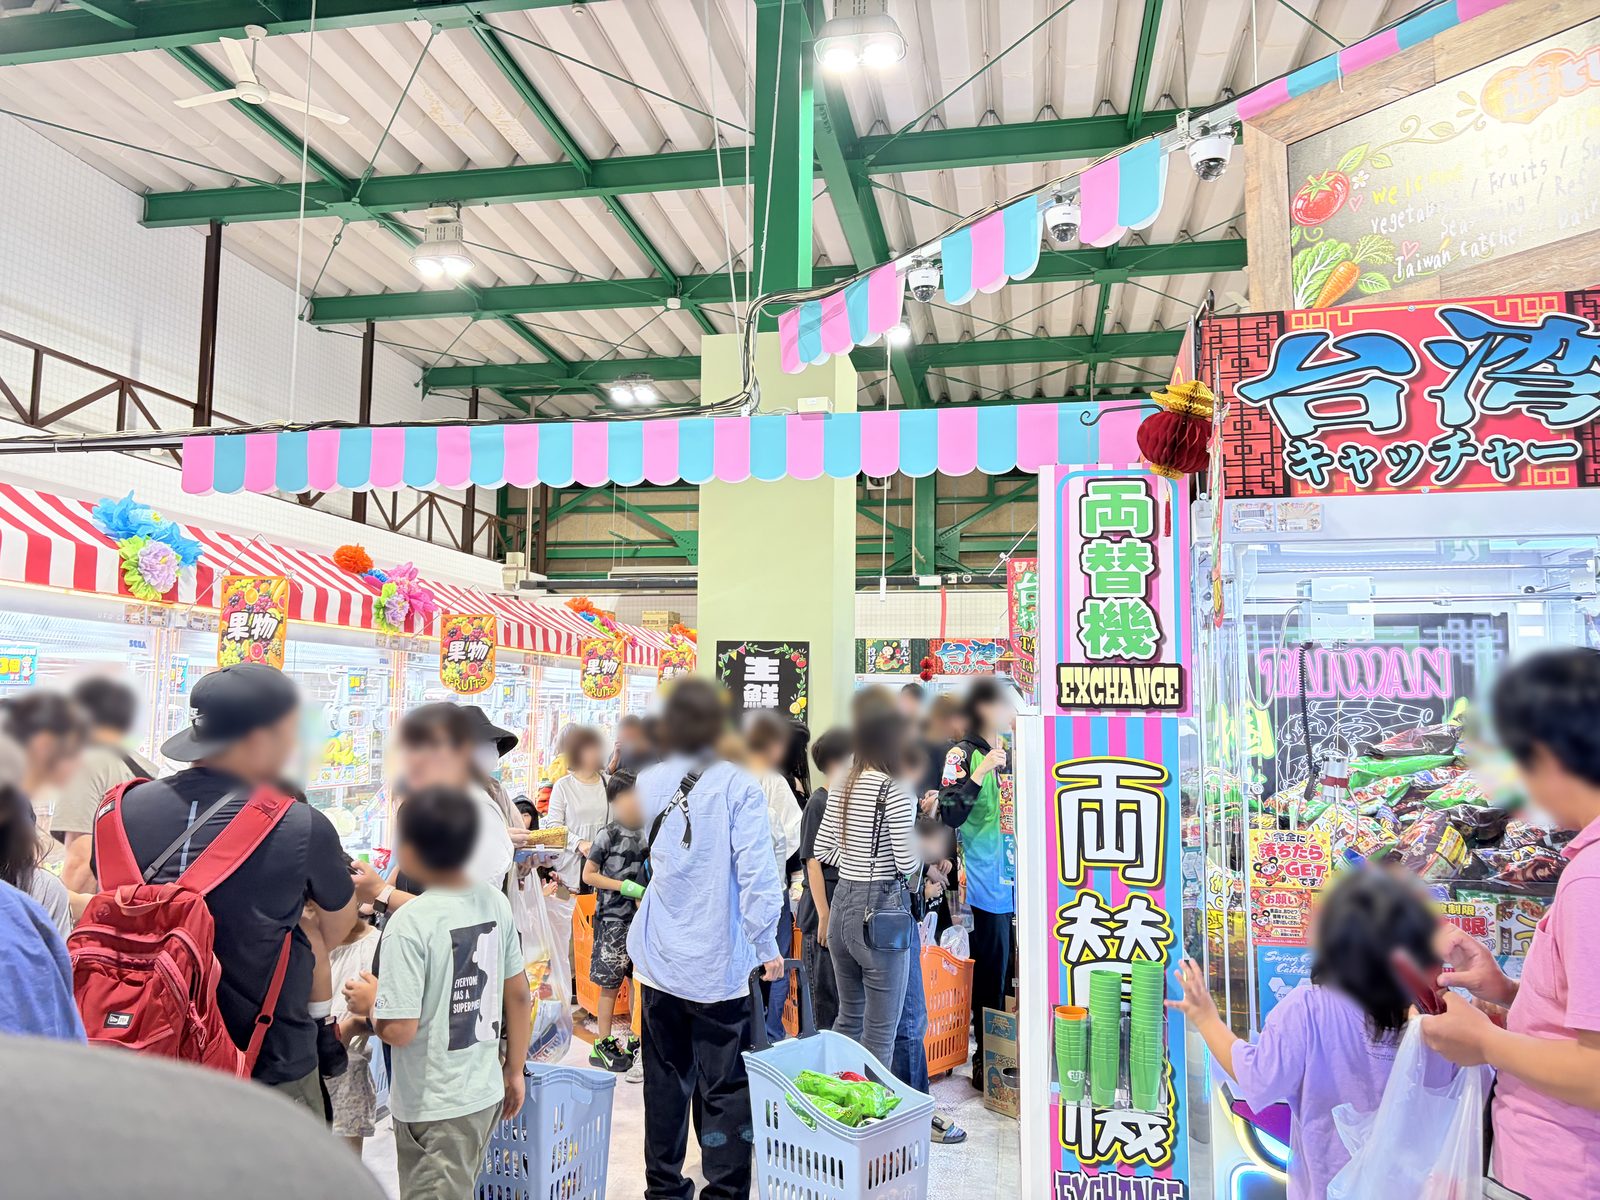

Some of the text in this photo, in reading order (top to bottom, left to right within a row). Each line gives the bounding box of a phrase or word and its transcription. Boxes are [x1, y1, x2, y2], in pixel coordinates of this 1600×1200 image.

[1395, 249, 1451, 279] Taiwan
[1233, 305, 1600, 434] 台湾
[1284, 427, 1581, 487] キャッチャー
[1078, 479, 1161, 660] 両替機
[227, 611, 280, 641] 果物
[129, 640, 147, 649] SEGA
[447, 640, 490, 661] 果物
[936, 640, 1005, 664] 台湾
[586, 659, 619, 675] 果物
[1259, 646, 1453, 699] TAIWAN
[743, 656, 780, 709] 生鮮
[1060, 666, 1180, 706] EXCHANGE
[1259, 843, 1324, 861] 落ちたら
[1284, 861, 1327, 878] GET
[1264, 893, 1299, 905] お願い
[1264, 950, 1299, 966] Swing
[453, 989, 470, 1000] HAS A
